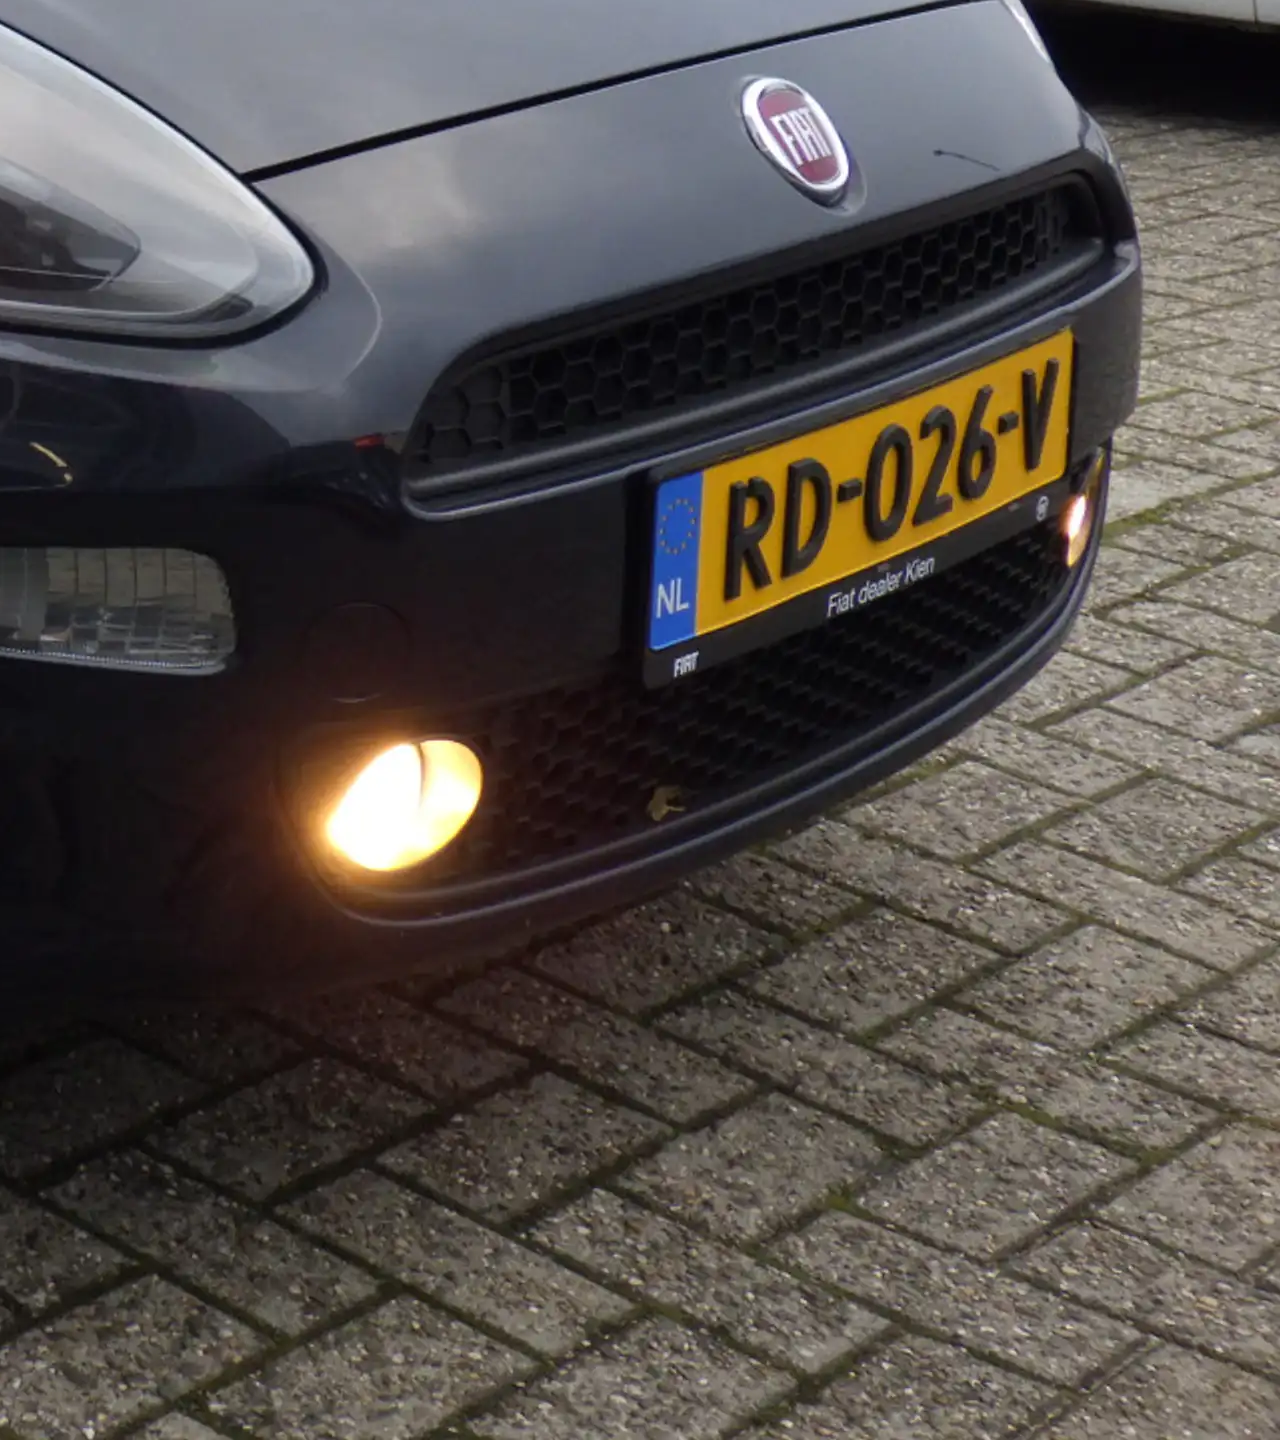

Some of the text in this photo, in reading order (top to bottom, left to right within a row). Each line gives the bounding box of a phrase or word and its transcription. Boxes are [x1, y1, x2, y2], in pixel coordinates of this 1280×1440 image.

[770, 107, 833, 166] FIAT
[724, 358, 1060, 602] RD-026-V
[655, 577, 690, 618] NL
[826, 556, 935, 617] Fiat dealer Kien
[673, 651, 700, 678] FIAT
